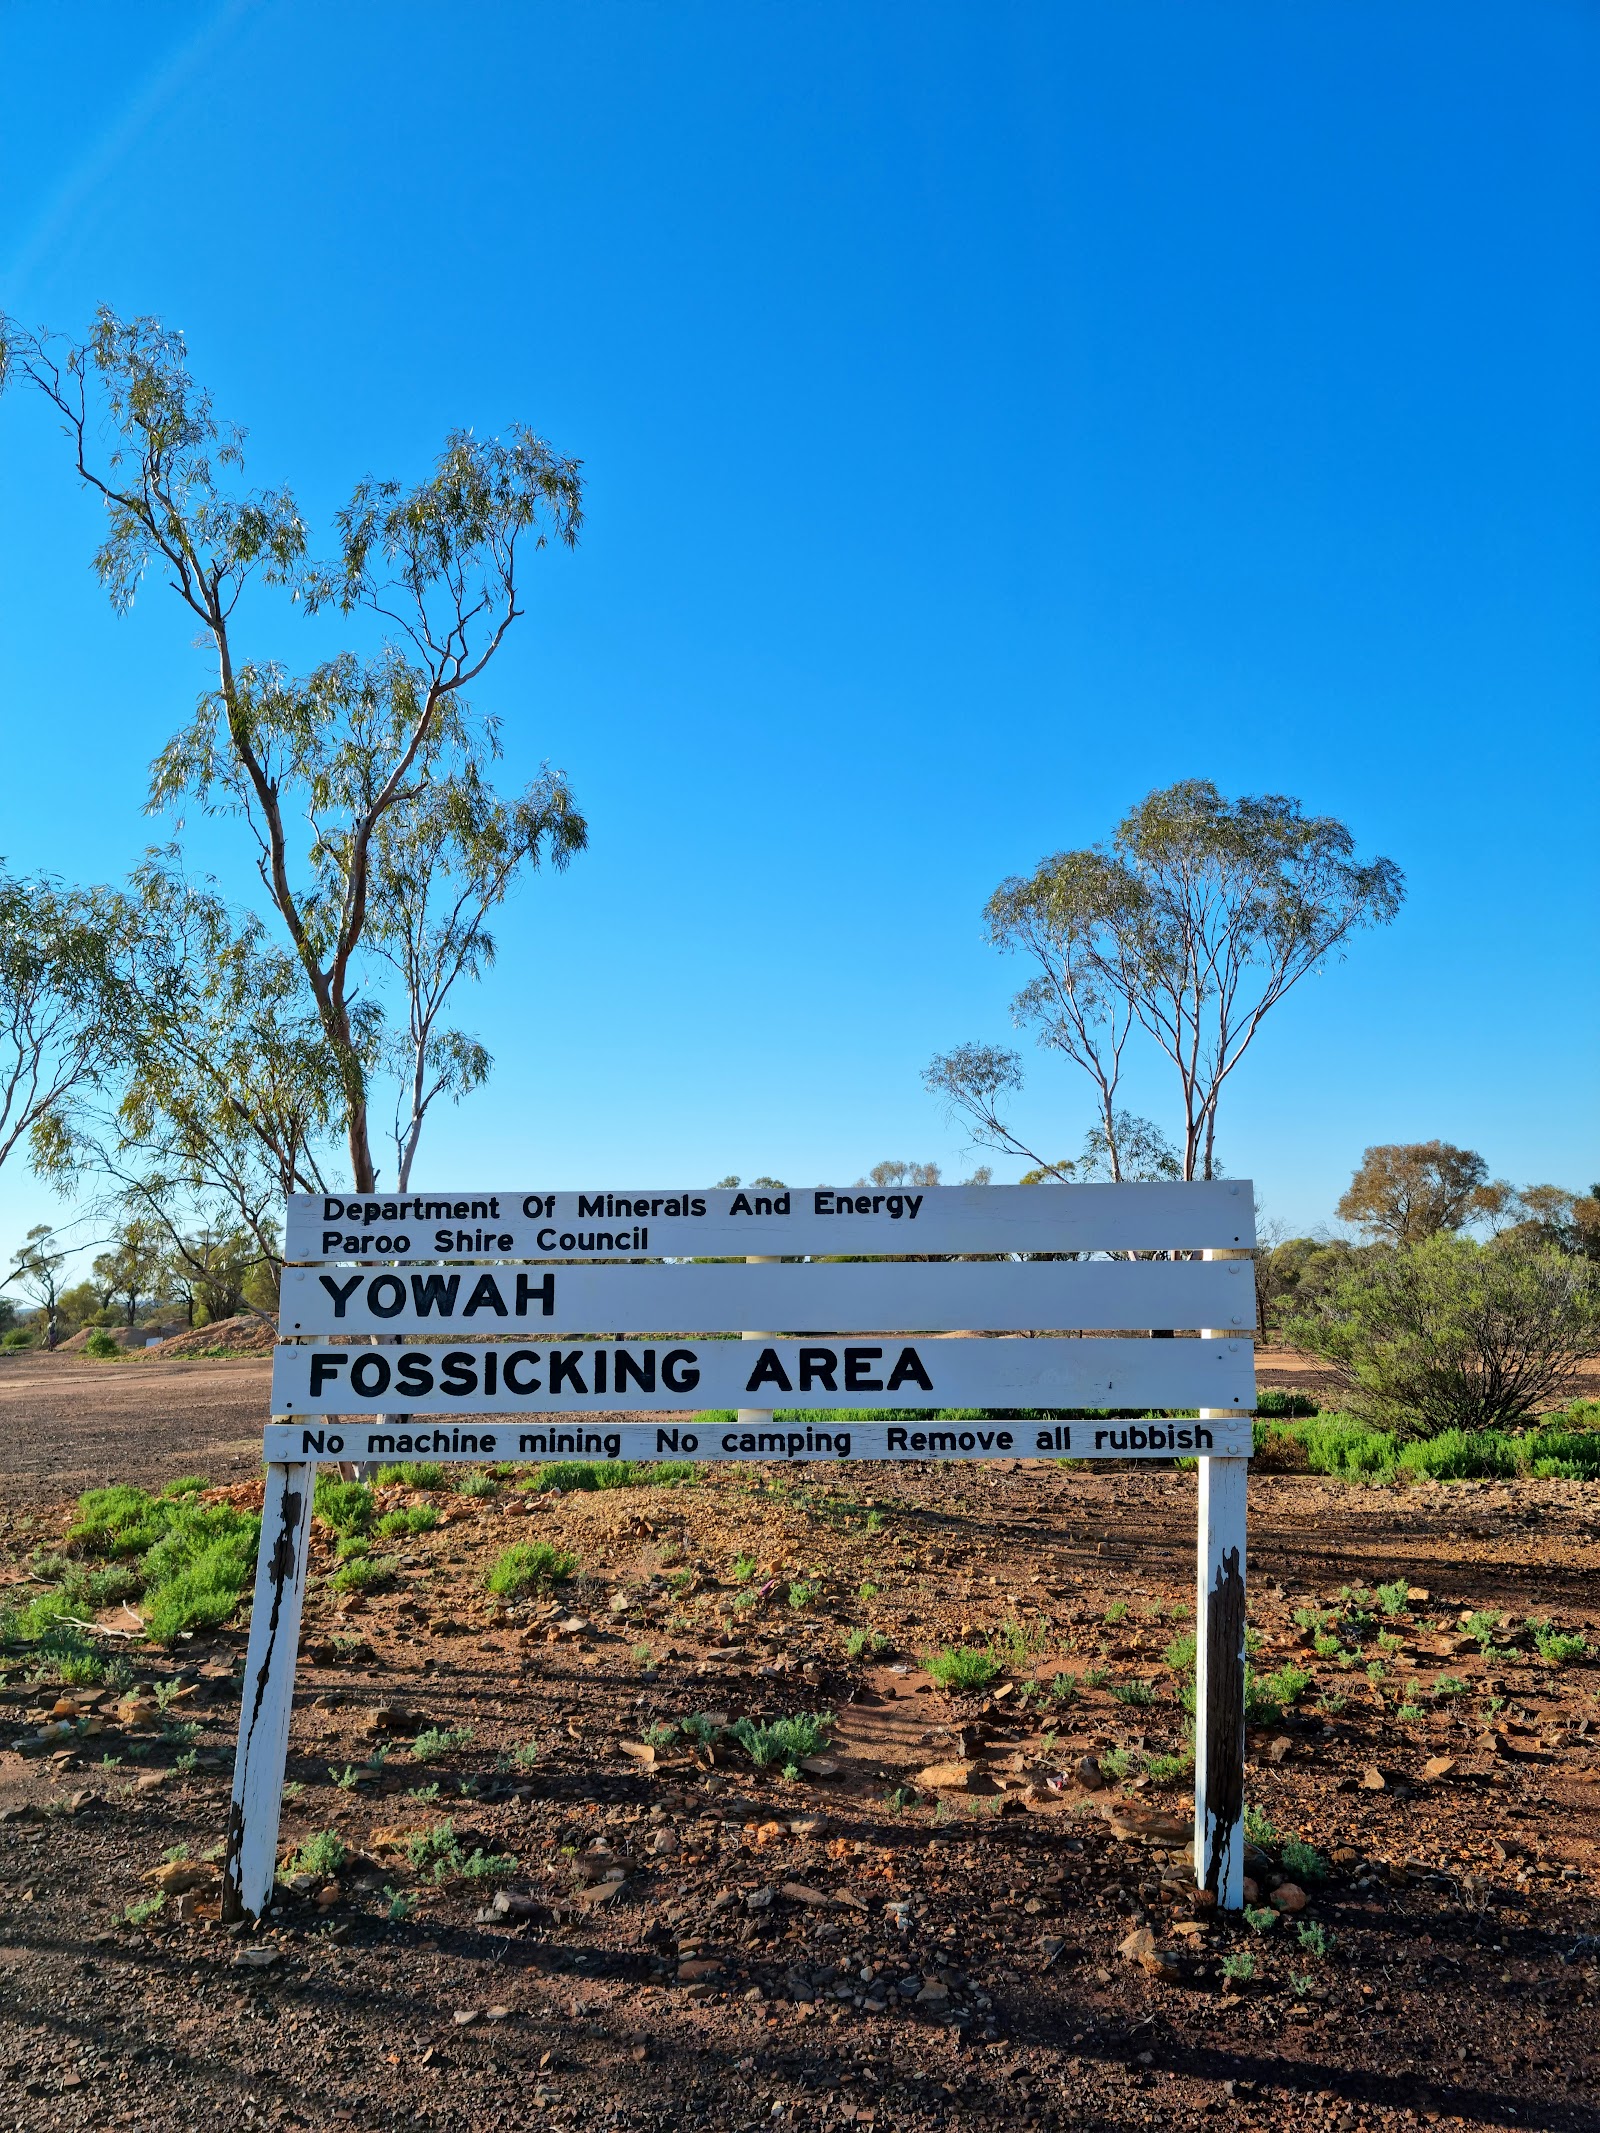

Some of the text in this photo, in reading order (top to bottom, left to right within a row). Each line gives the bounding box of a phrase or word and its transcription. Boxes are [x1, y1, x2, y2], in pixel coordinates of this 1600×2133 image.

[322, 1191, 924, 1226] Department Of Minerals And Energy
[321, 1227, 648, 1255] Paroo Shire Council
[318, 1273, 555, 1319] YOWAH
[308, 1347, 934, 1398] FOSSICKING AREA
[302, 1422, 1214, 1459] No machine mining No camping Remove all rubbish
